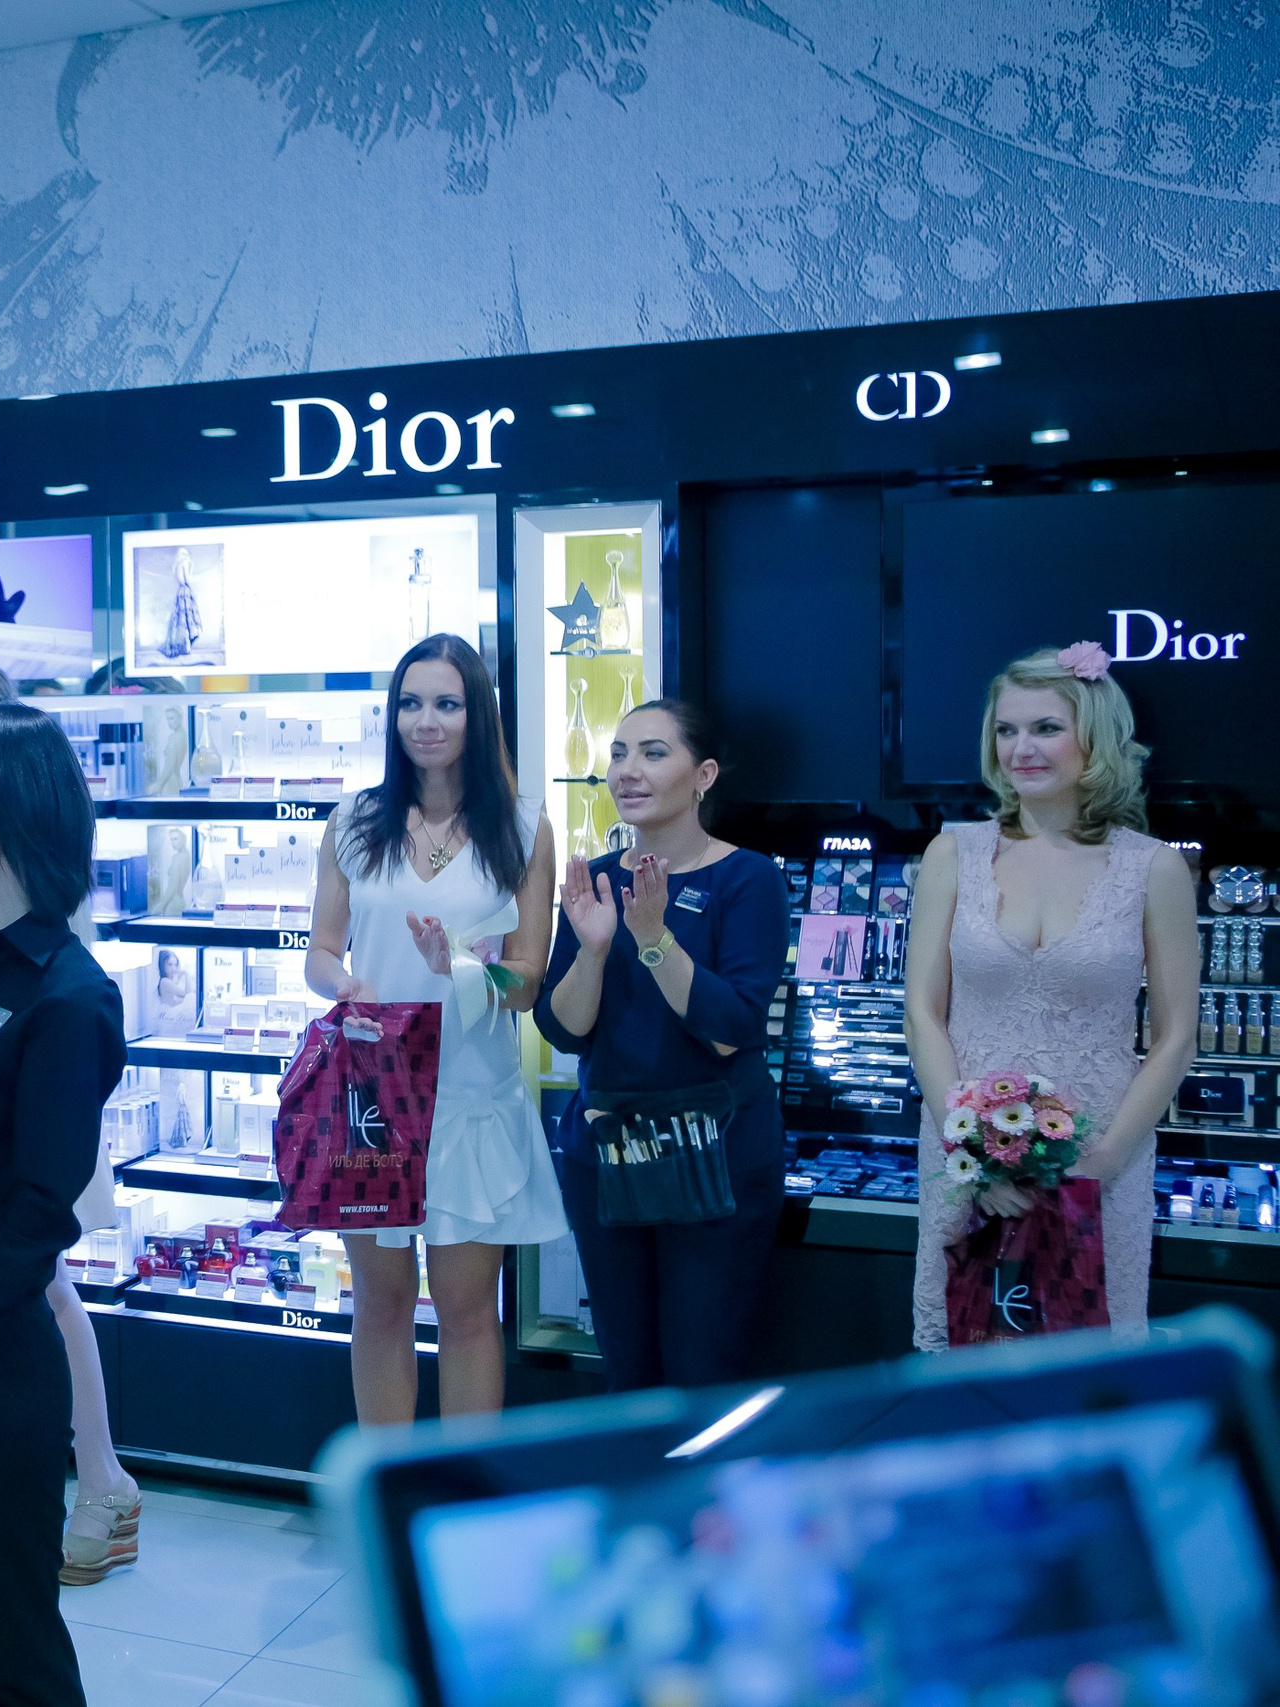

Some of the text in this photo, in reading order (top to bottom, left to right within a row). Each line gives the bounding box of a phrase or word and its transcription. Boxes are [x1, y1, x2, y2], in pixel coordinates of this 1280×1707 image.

[270, 391, 515, 483] Dior
[1108, 608, 1246, 664] Dior
[276, 802, 317, 820] Dior
[823, 837, 872, 851] ГЛАЗА
[278, 931, 310, 949] Dio
[1200, 1088, 1222, 1098] Dior
[354, 1155, 371, 1170] ДЕ
[282, 1310, 322, 1330] Dior
